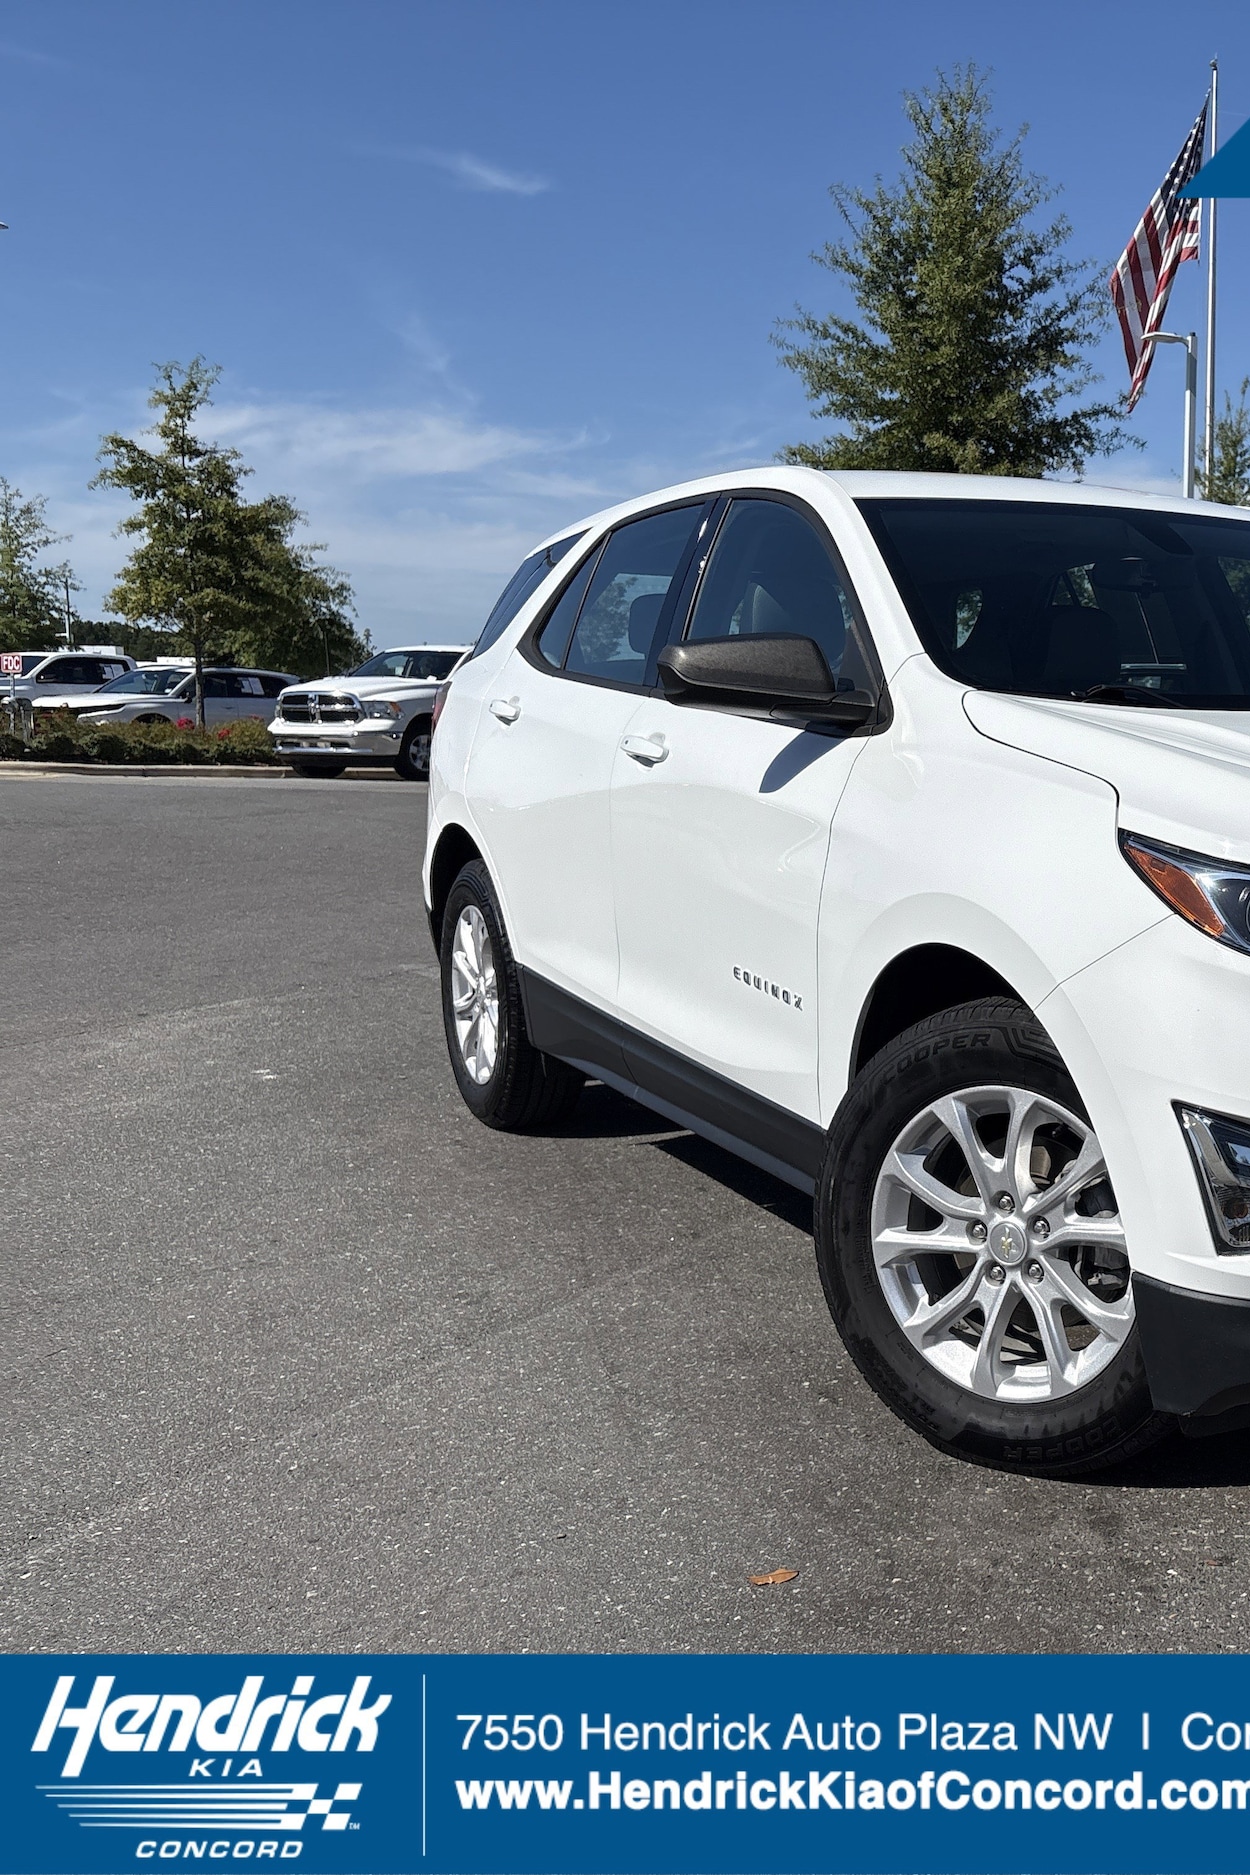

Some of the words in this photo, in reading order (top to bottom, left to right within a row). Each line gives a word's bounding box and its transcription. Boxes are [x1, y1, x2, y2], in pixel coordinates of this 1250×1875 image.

[3, 656, 20, 670] FDC
[732, 965, 804, 1012] EQUINOX
[883, 1033, 992, 1085] COOPER
